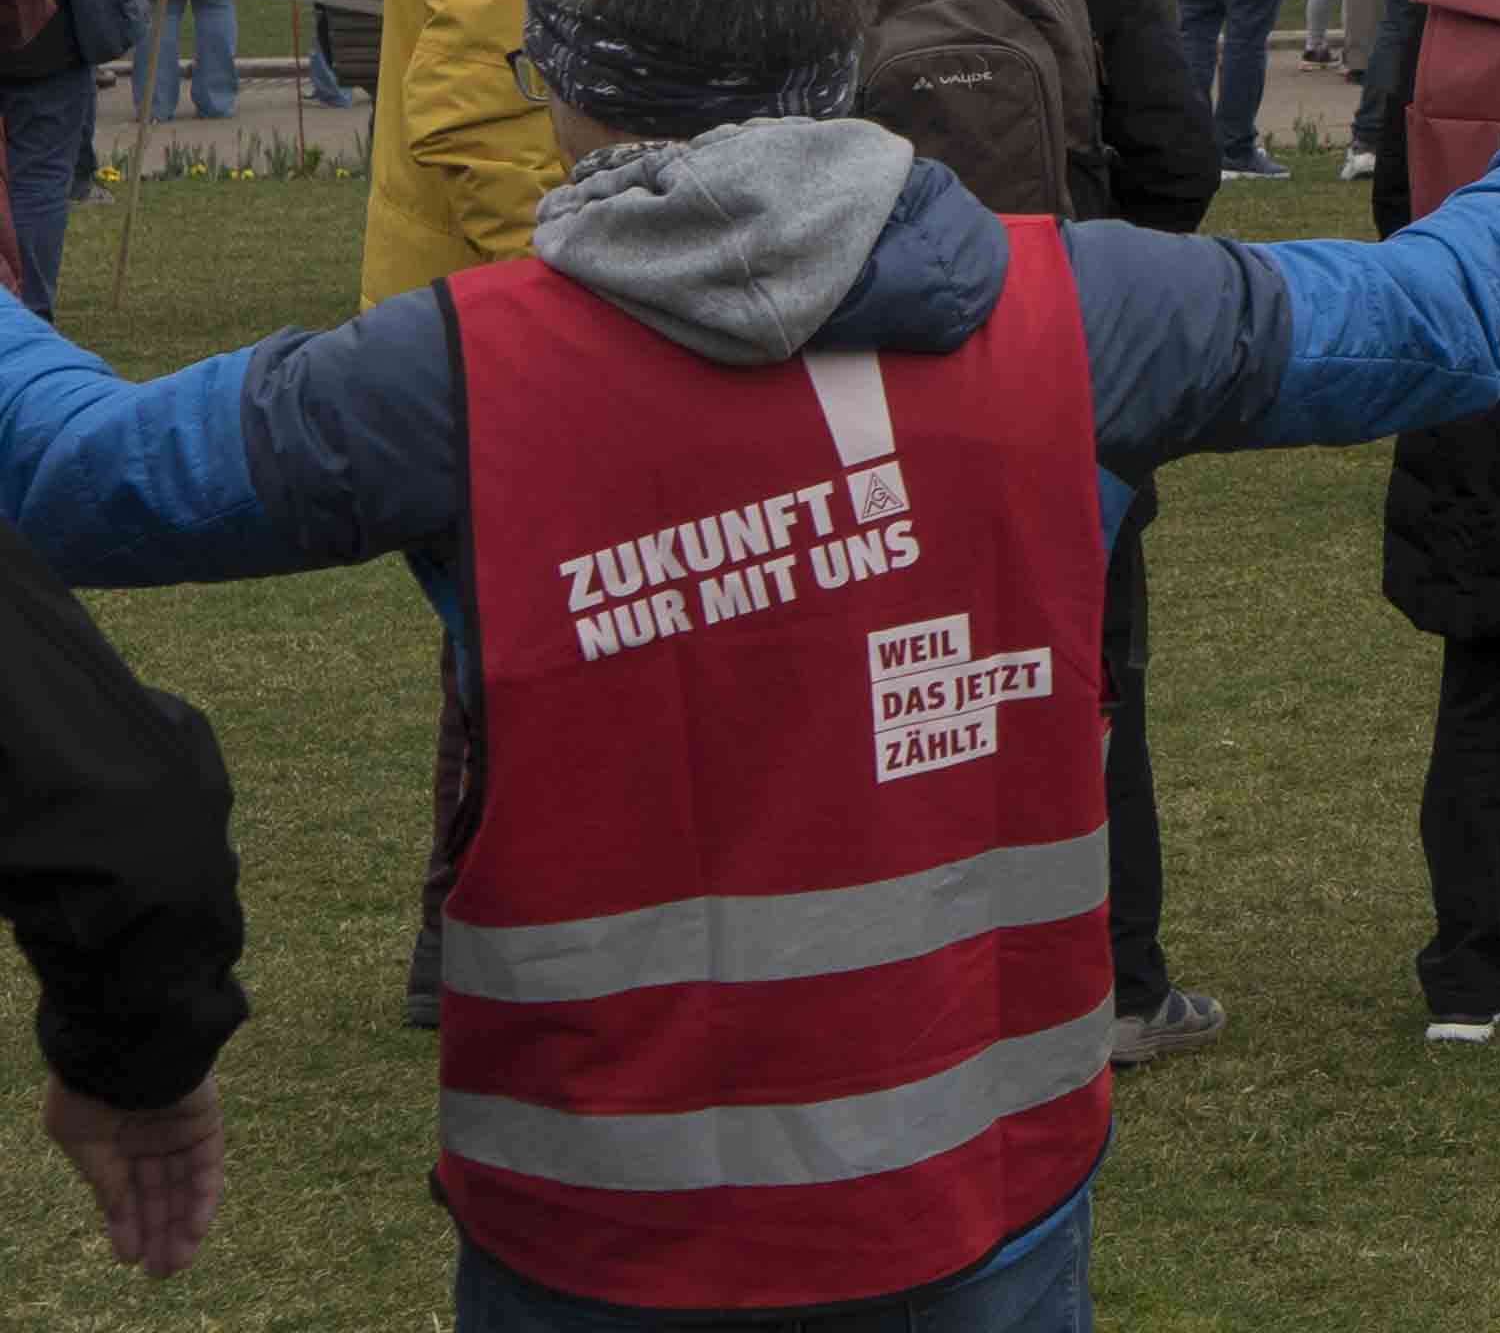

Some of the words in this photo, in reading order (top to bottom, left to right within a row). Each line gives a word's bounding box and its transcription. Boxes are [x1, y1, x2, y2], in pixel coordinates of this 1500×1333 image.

[559, 480, 835, 614] ZUKUNFT
[575, 588, 694, 662] NUR
[698, 554, 797, 626] MIT
[809, 519, 921, 590] UNS
[878, 629, 958, 670] WEIL
[881, 681, 945, 721] DAS
[954, 661, 1041, 711] JETZT
[885, 722, 987, 771] ZÄHLT.
